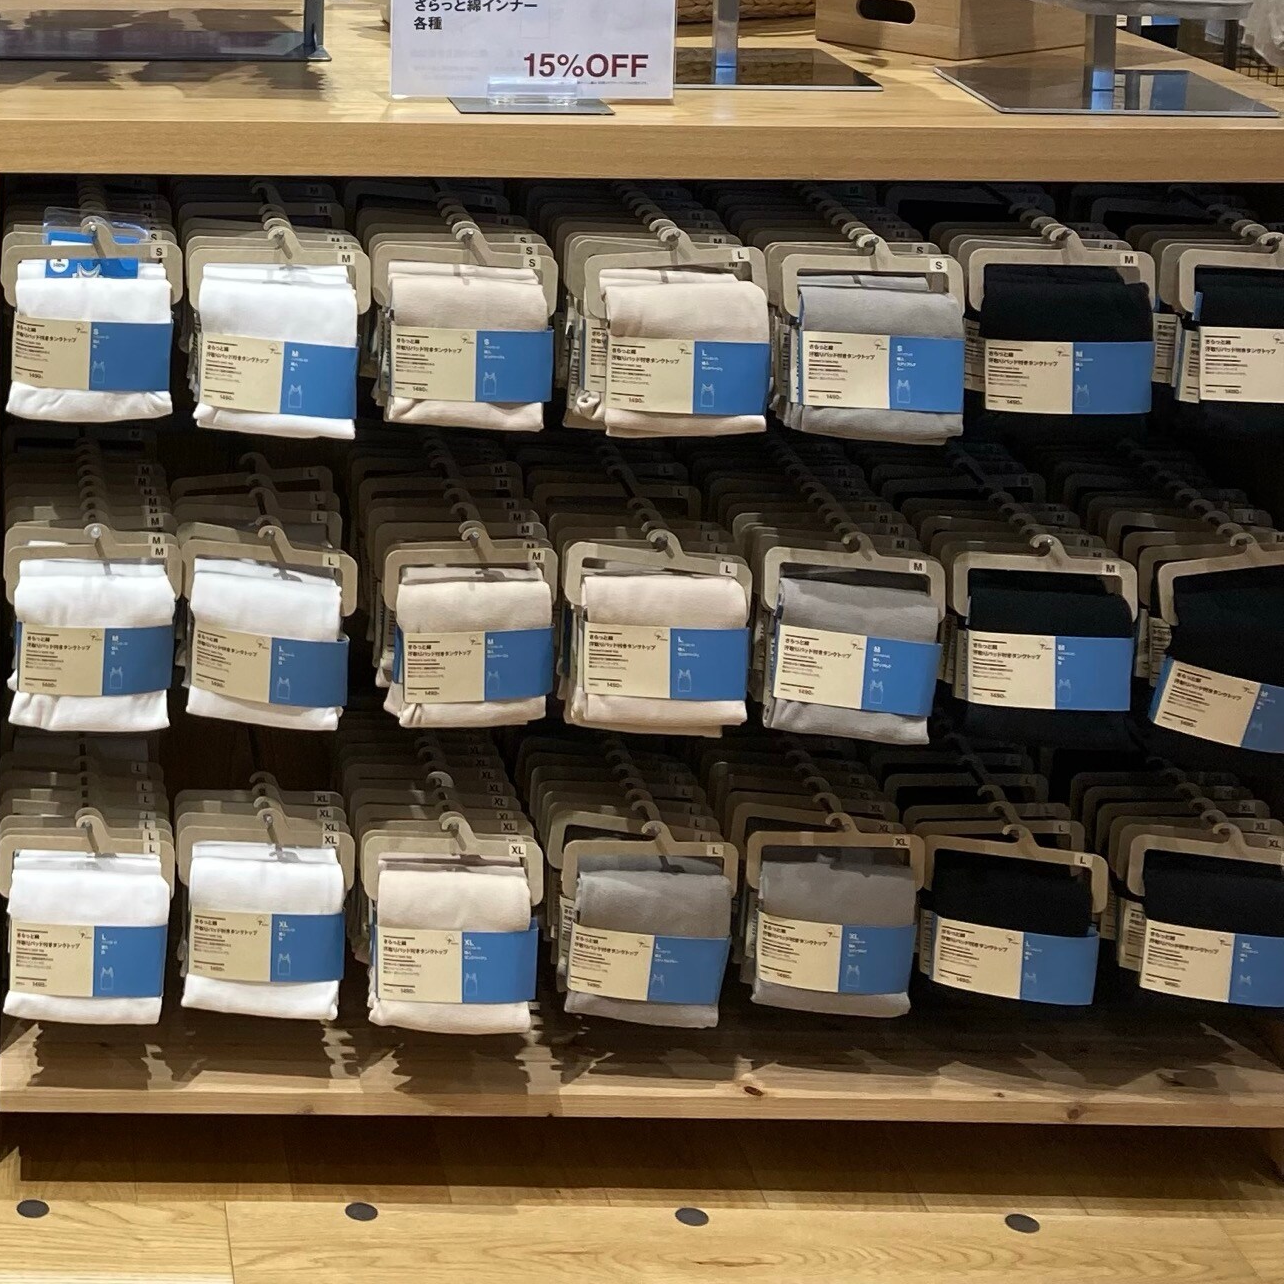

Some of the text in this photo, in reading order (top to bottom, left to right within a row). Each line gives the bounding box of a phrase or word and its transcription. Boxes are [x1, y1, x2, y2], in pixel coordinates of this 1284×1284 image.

[414, 17, 442, 30] 各種
[524, 54, 649, 78] 15%OFF
[155, 247, 163, 256] S
[737, 251, 745, 259] L
[341, 254, 351, 263] M
[528, 258, 536, 268] S
[1124, 255, 1134, 265] M
[935, 260, 943, 270] S
[155, 547, 164, 555] M
[327, 557, 335, 565] L
[532, 552, 542, 561] M
[724, 564, 732, 573] L
[913, 562, 923, 571] M
[319, 809, 332, 818] XL
[324, 823, 338, 831] XL
[324, 835, 338, 844] XL
[895, 838, 909, 848] XL
[149, 844, 156, 853] L
[511, 845, 525, 855] XL
[712, 846, 719, 855] L
[1079, 856, 1087, 865] L
